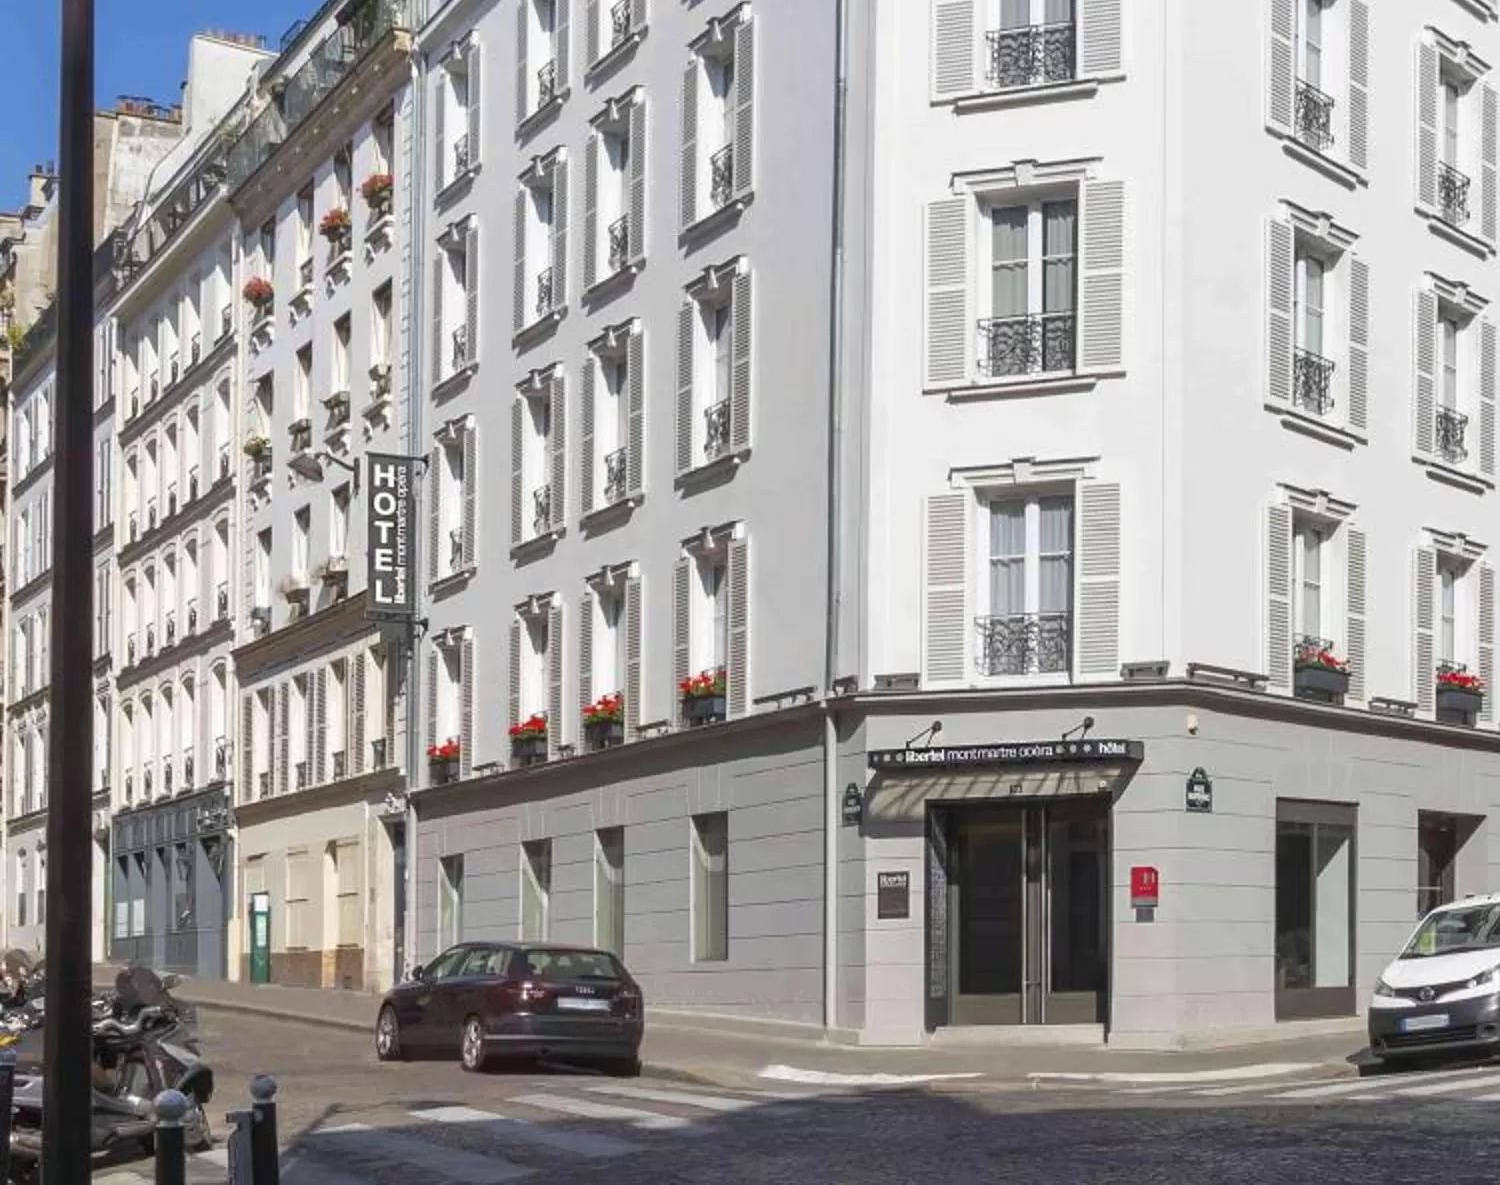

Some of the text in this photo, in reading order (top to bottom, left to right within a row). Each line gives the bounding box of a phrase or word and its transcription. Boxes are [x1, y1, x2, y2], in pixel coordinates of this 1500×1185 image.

[373, 464, 397, 605] HOTEL
[396, 500, 407, 565] montmartre
[394, 567, 406, 605] libertel
[905, 748, 945, 763] libertel
[947, 746, 1017, 760] montmartre
[1099, 740, 1126, 754] hôtel
[1143, 870, 1156, 884] H
